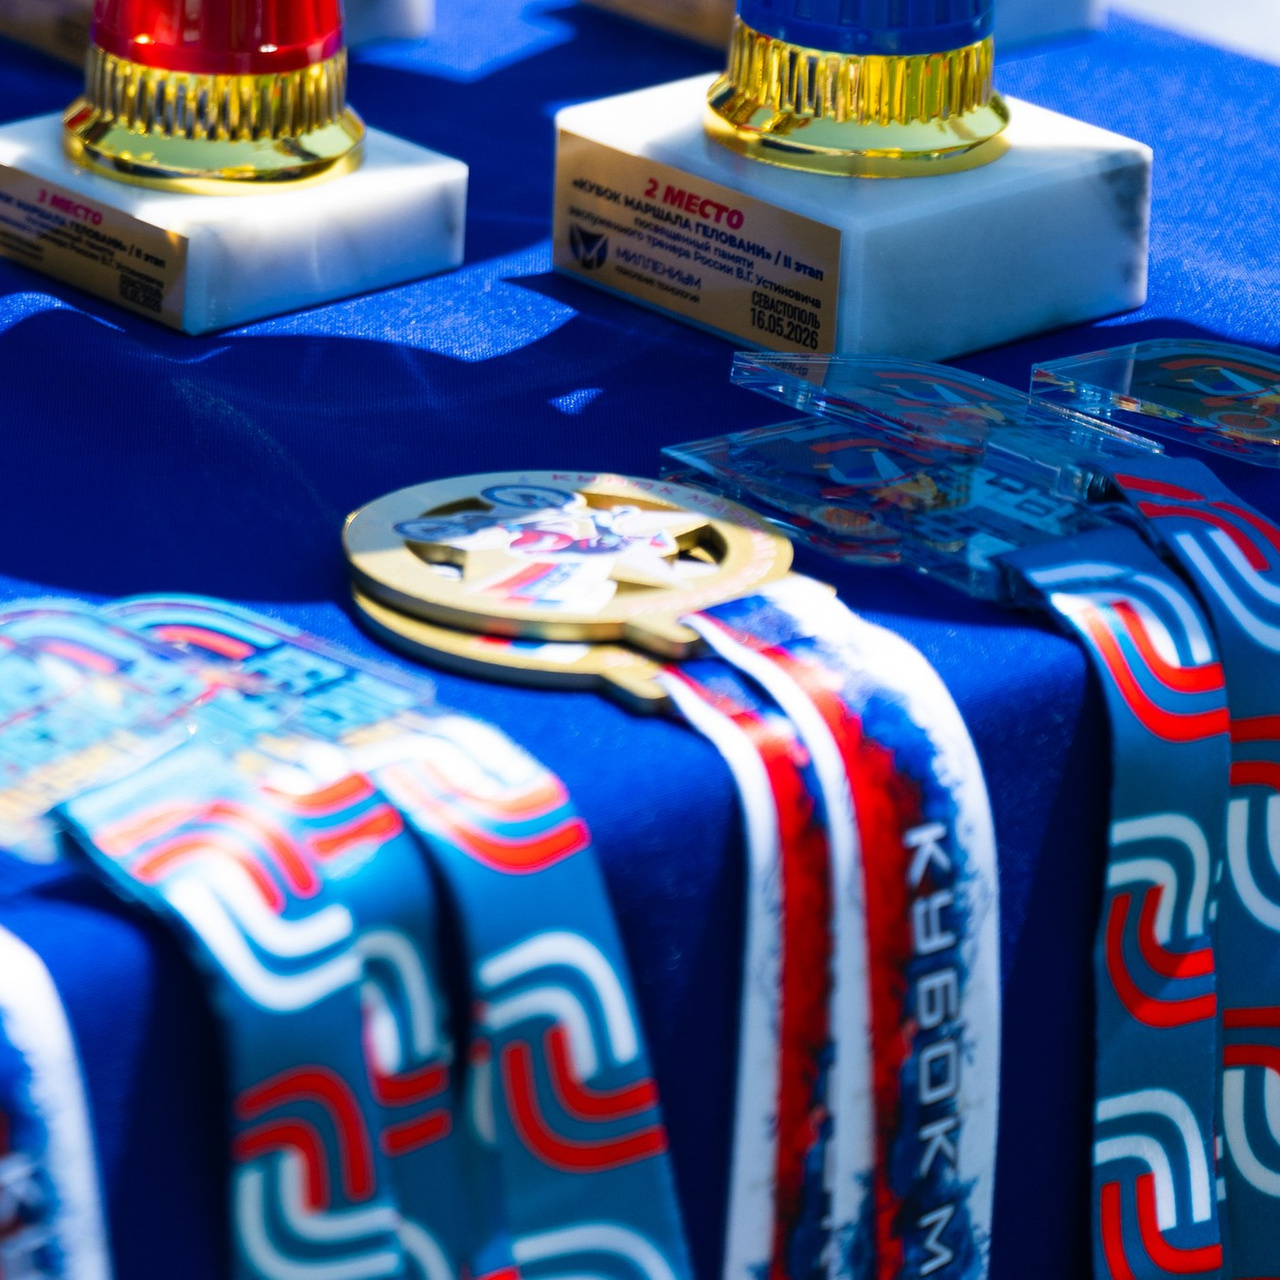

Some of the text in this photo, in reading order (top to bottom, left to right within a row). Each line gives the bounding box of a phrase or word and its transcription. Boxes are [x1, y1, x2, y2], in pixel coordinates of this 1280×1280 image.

[49, 194, 103, 226] МЕСТО
[644, 178, 744, 230] 2 МЕСТО
[625, 197, 693, 232] МАРШАЛА
[695, 223, 772, 264] ГЕЛОВАНИ»
[773, 250, 782, 269] /
[793, 260, 824, 282] этап
[715, 246, 754, 269] памяти
[646, 235, 691, 260] тренера
[694, 252, 738, 276] России
[736, 267, 754, 284] В.Г.
[756, 274, 822, 309] Устиновича
[750, 308, 819, 350] 16.05.2026
[751, 291, 821, 330] СЕВАСТОПОЛЬ
[903, 823, 960, 1179] КУБОК
